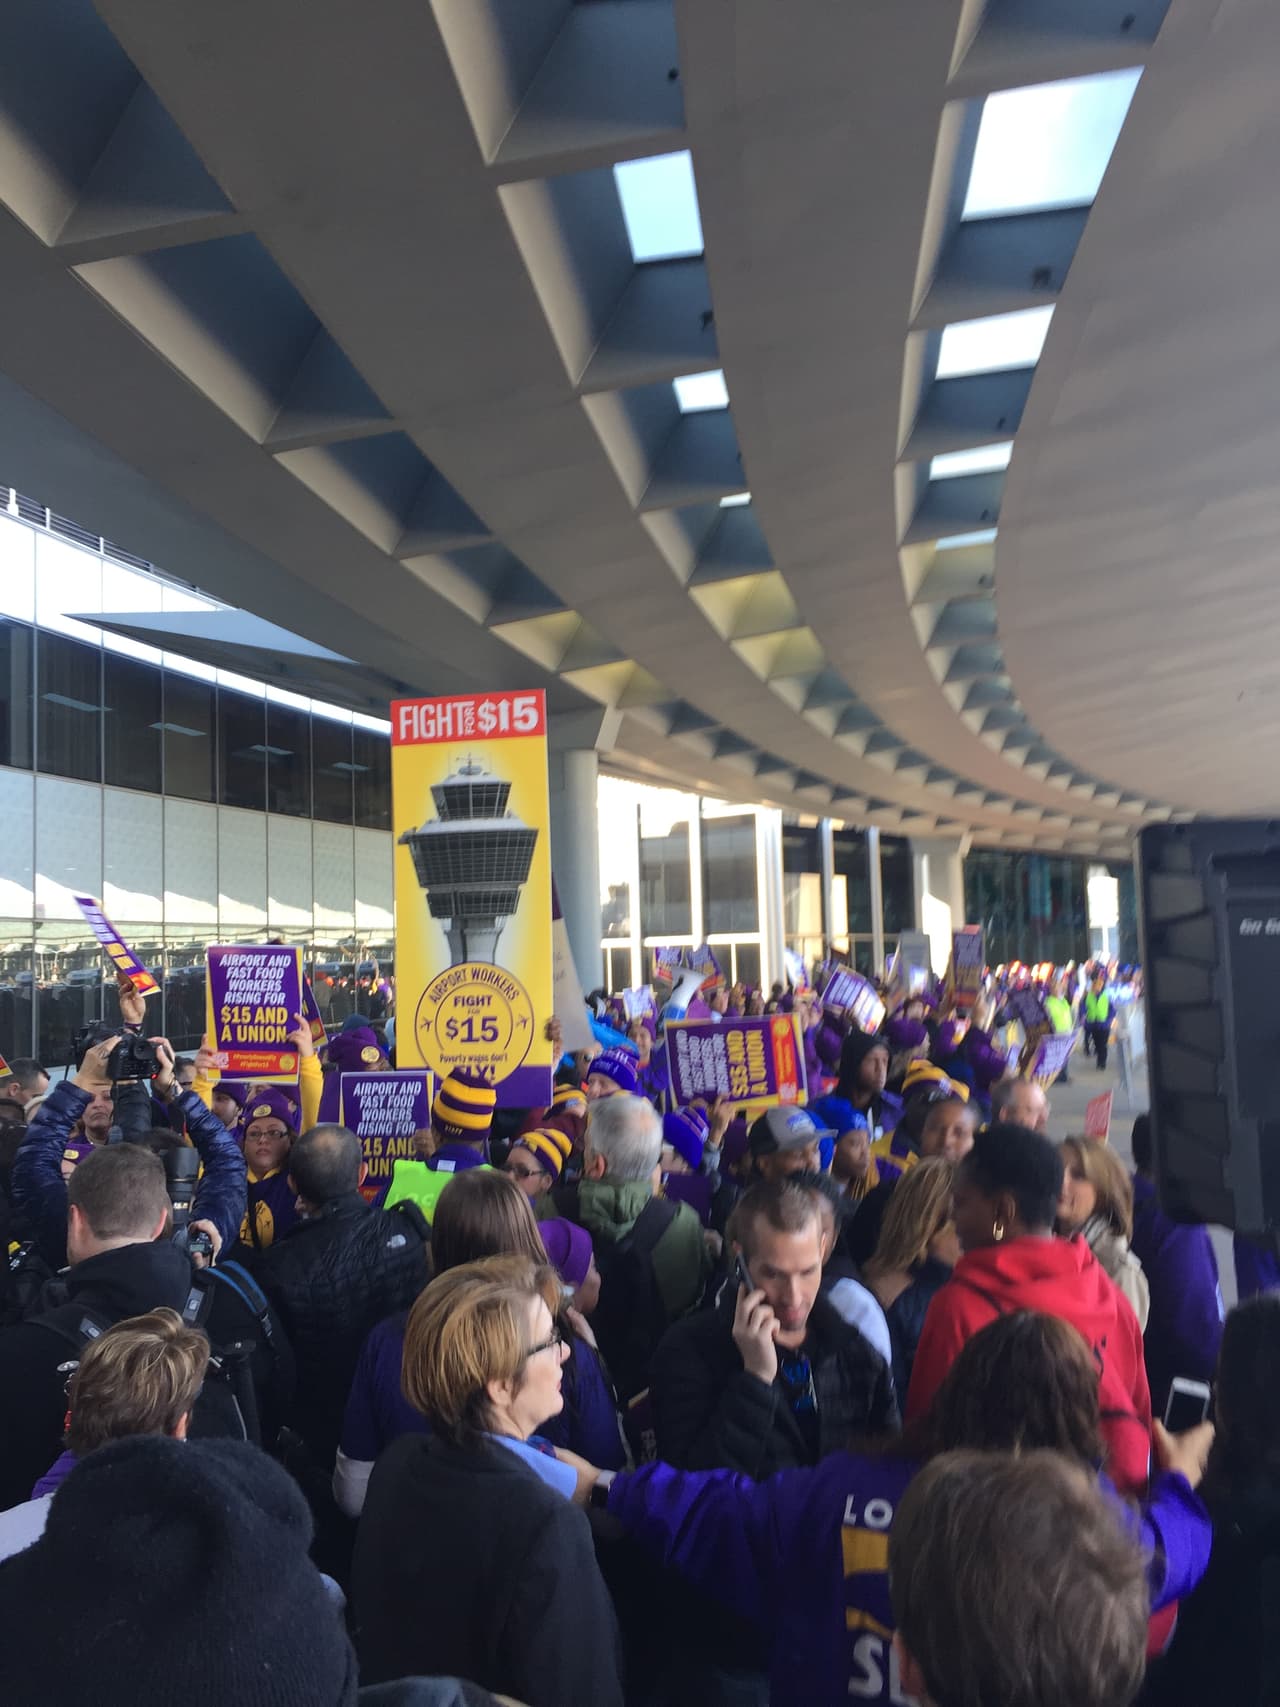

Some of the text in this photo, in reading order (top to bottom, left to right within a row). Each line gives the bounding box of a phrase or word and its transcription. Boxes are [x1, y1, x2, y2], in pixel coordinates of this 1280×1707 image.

[399, 696, 539, 740] FIGHT FOR $15
[219, 954, 292, 968] AIRPORT AND
[226, 967, 285, 980] FAST FOOD
[229, 979, 282, 992] WORKERS
[429, 967, 520, 1004] AIRPORT WORKERS
[224, 992, 286, 1005] RISING FOR
[454, 995, 493, 1008] FIGHT
[221, 1005, 251, 1024] $15
[254, 1007, 289, 1025] AND
[221, 1025, 287, 1044] A UNION
[446, 1015, 499, 1043] $15
[726, 1030, 746, 1065] AND
[440, 1053, 466, 1064] Poverty
[468, 1055, 489, 1064] wages
[745, 1029, 769, 1095] A UNION
[354, 1081, 422, 1096] AIRPORT AND
[360, 1095, 415, 1109] FAST FOOD
[362, 1108, 412, 1122] WORKERS
[357, 1121, 416, 1136] RISING FOR
[357, 1137, 383, 1156] 15
[842, 1493, 894, 1529] LO
